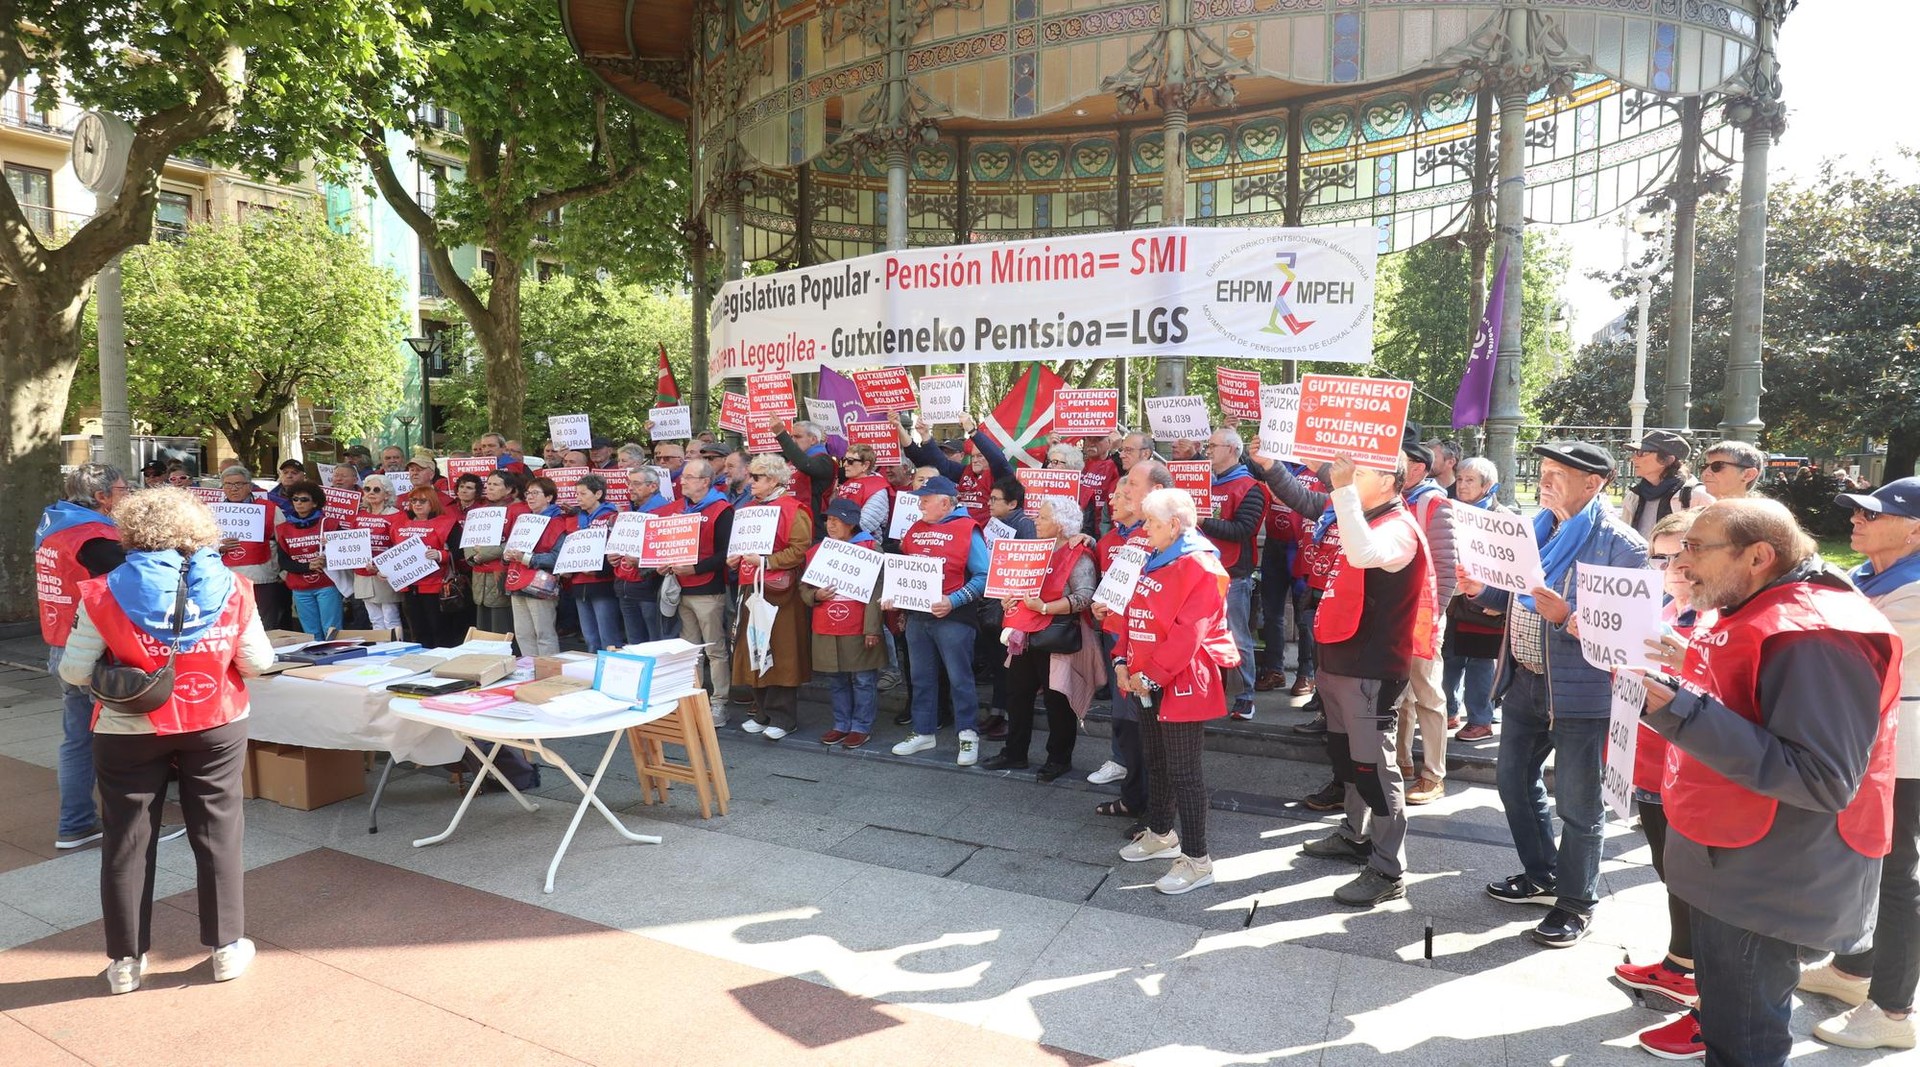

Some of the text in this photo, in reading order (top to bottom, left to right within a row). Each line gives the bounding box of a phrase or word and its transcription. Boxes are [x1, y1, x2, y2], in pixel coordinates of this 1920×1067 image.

[1206, 253, 1231, 277] EUSKAL
[1230, 238, 1266, 255] HERRIKO
[723, 278, 796, 323] egislativa
[801, 265, 871, 310] Popular
[885, 252, 981, 291] Pensión
[1130, 236, 1188, 275] SMI
[1216, 280, 1354, 304] EHPM MPEH
[1202, 303, 1371, 353] MOVIMIENTO DE PENSIONISTAS DE EUSKAL HERRIA
[741, 332, 815, 372] Legegilea
[832, 317, 965, 359] Gutxieneko
[750, 372, 791, 382] GUTXIENEKO
[856, 370, 905, 380] GUTXIENEKO
[758, 382, 788, 390] PENTSIOA
[921, 380, 963, 390] GIPUZKOAN
[1308, 380, 1408, 399] GUTXIENEKO
[754, 394, 792, 402] GUTXIENEKO
[865, 388, 910, 398] GUTXIENEKO
[1059, 391, 1117, 400] GUTXIENEKO
[874, 396, 906, 404] SOLDATA
[930, 396, 952, 405] 48.039
[1147, 397, 1202, 410] GIPUZKOAN
[1320, 395, 1391, 412] PENTSIOA
[1162, 414, 1192, 424] 48.039
[1268, 419, 1294, 433] 48.03
[1306, 417, 1398, 438] GUTXIENEKO
[1154, 426, 1210, 439] SINADURAK
[1315, 431, 1378, 450] SOLDATA
[1170, 464, 1210, 472] GUTXIENEKO
[1020, 472, 1079, 480] GUTXIENEKO
[1028, 480, 1070, 489] PENTSIOA
[735, 508, 778, 521] GIPUZKOAN
[649, 516, 699, 528] GUTXIENEKO
[1456, 508, 1528, 538] GIPUZKOA
[618, 528, 640, 538] 48.039
[658, 525, 692, 536] PENTSIOA
[738, 524, 762, 535] 48.039
[326, 531, 368, 541] GIPUZKOAN
[464, 536, 491, 545] FIRMAS
[338, 544, 361, 553] 48.039
[606, 542, 640, 552] SINADURA
[648, 538, 696, 549] GUTXIENEKO
[999, 542, 1054, 552] GUTXIENEKO
[376, 538, 420, 566] GIPUZKOAN
[567, 545, 591, 554] 48.039
[656, 548, 688, 557] SOLDATA
[823, 540, 882, 566] GIPUZKOAN
[1470, 539, 1516, 562] 48.039
[1008, 552, 1046, 562] PENTSIOA
[393, 555, 418, 572] 48.039
[556, 559, 601, 570] SINADURAK
[826, 558, 861, 577] 48.039
[887, 558, 938, 574] GIPUZKOA
[391, 561, 436, 589] SINADURAK
[996, 568, 1044, 577] GUTXIENEKO
[1472, 564, 1526, 590] FIRMAS
[806, 569, 870, 599] SINADURAK
[896, 577, 928, 591] 48.039
[1004, 578, 1036, 586] SOLDATA
[893, 595, 931, 609] FIRMAS
[1582, 609, 1622, 632] 48.039
[1582, 638, 1628, 666] FIRMAS
